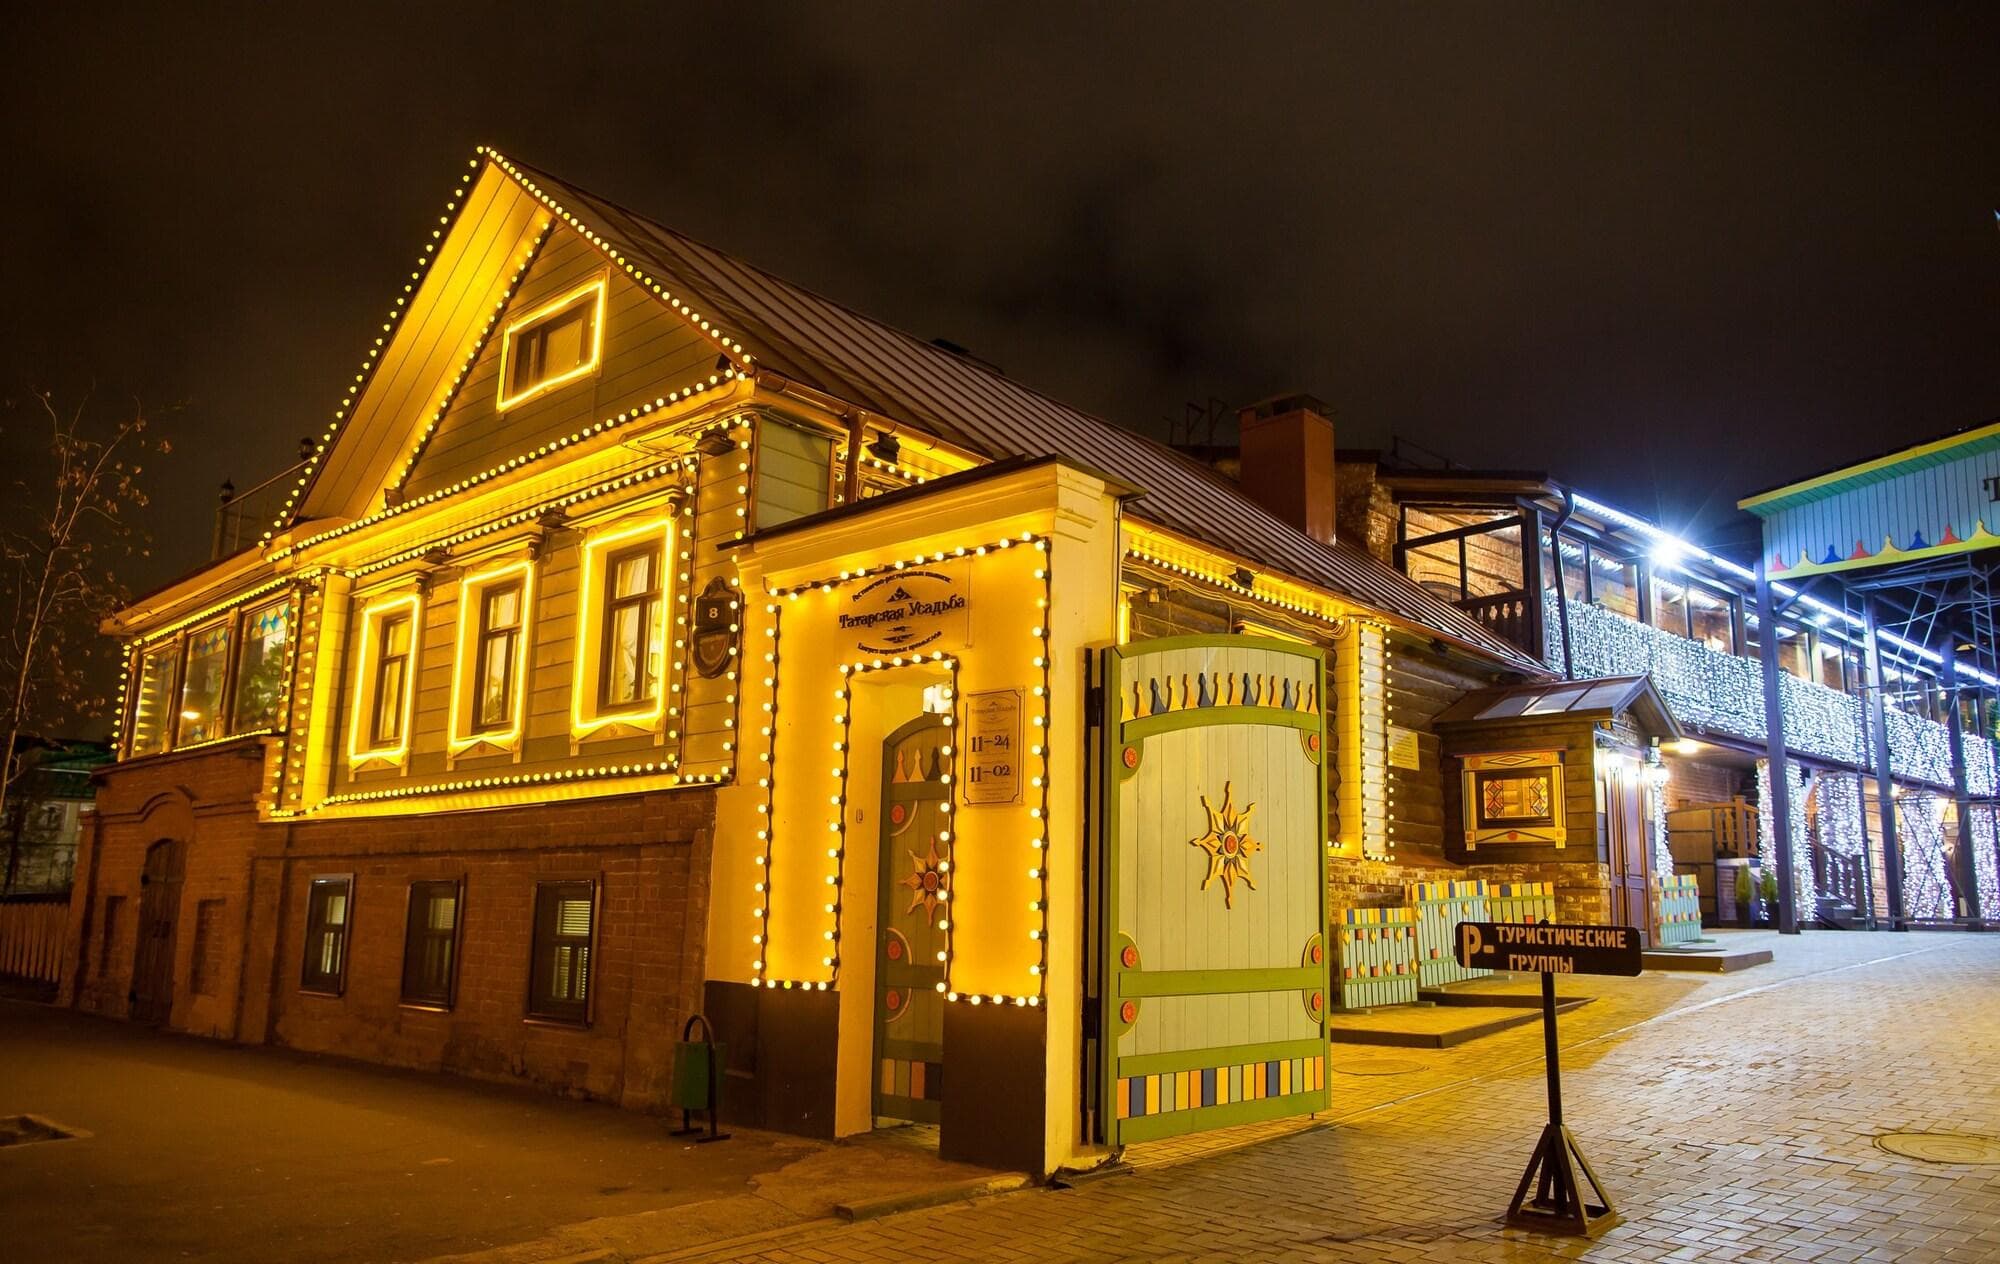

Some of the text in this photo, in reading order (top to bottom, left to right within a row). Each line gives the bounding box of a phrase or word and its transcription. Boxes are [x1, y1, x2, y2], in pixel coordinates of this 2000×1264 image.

[709, 608, 718, 618] 8
[839, 593, 965, 628] Татарская Усадьба
[1496, 926, 1627, 949] ТУРИСТИЧЕСКИЕ
[1508, 954, 1574, 974] ГРУППЫ
